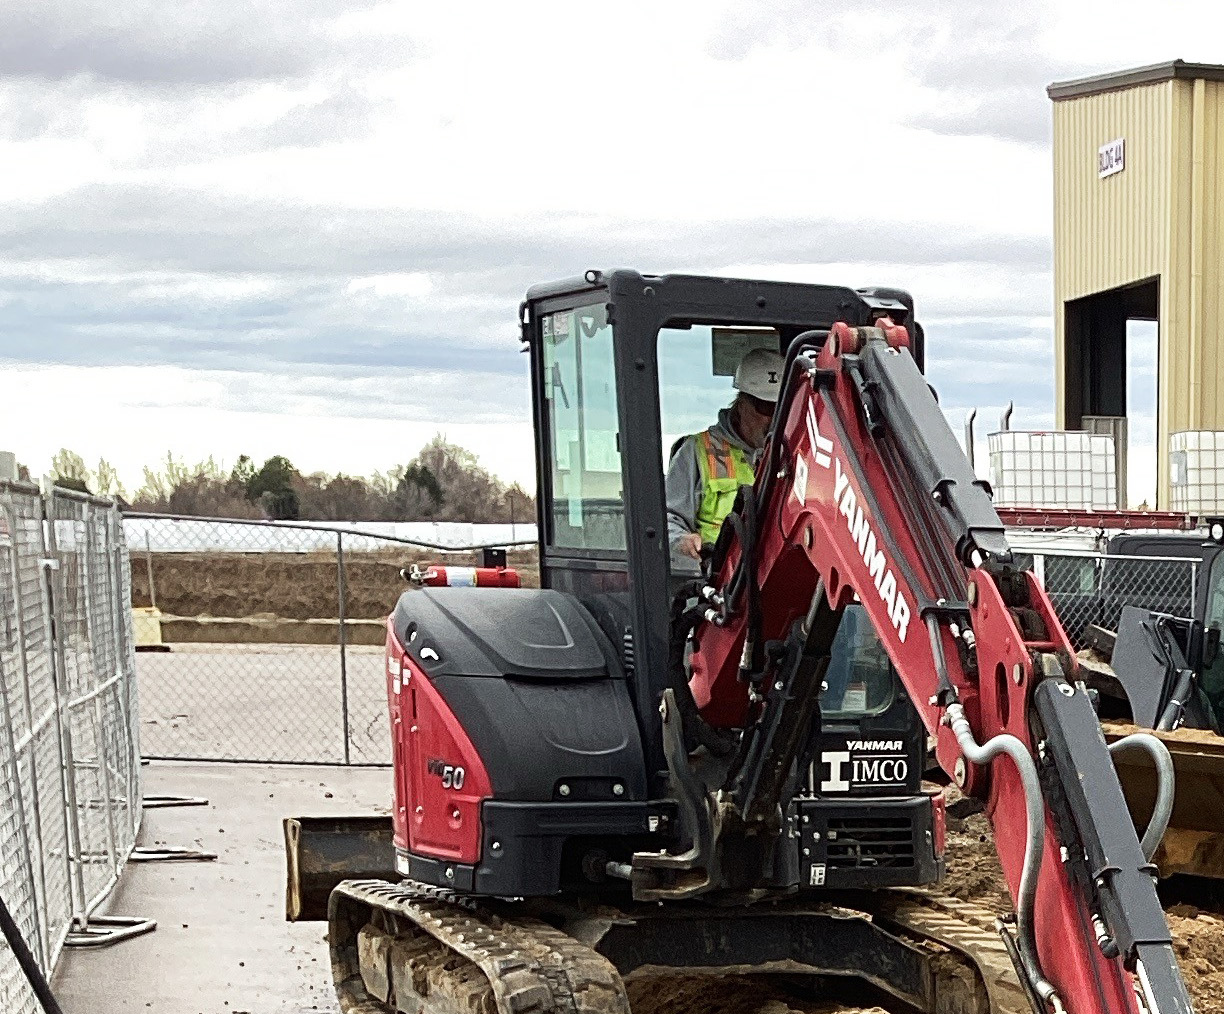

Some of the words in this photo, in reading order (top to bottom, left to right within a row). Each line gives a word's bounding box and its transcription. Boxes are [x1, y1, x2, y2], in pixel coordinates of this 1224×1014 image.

[834, 457, 911, 643] YANMAR
[846, 740, 903, 751] YANMAR
[851, 759, 908, 782] IMCO
